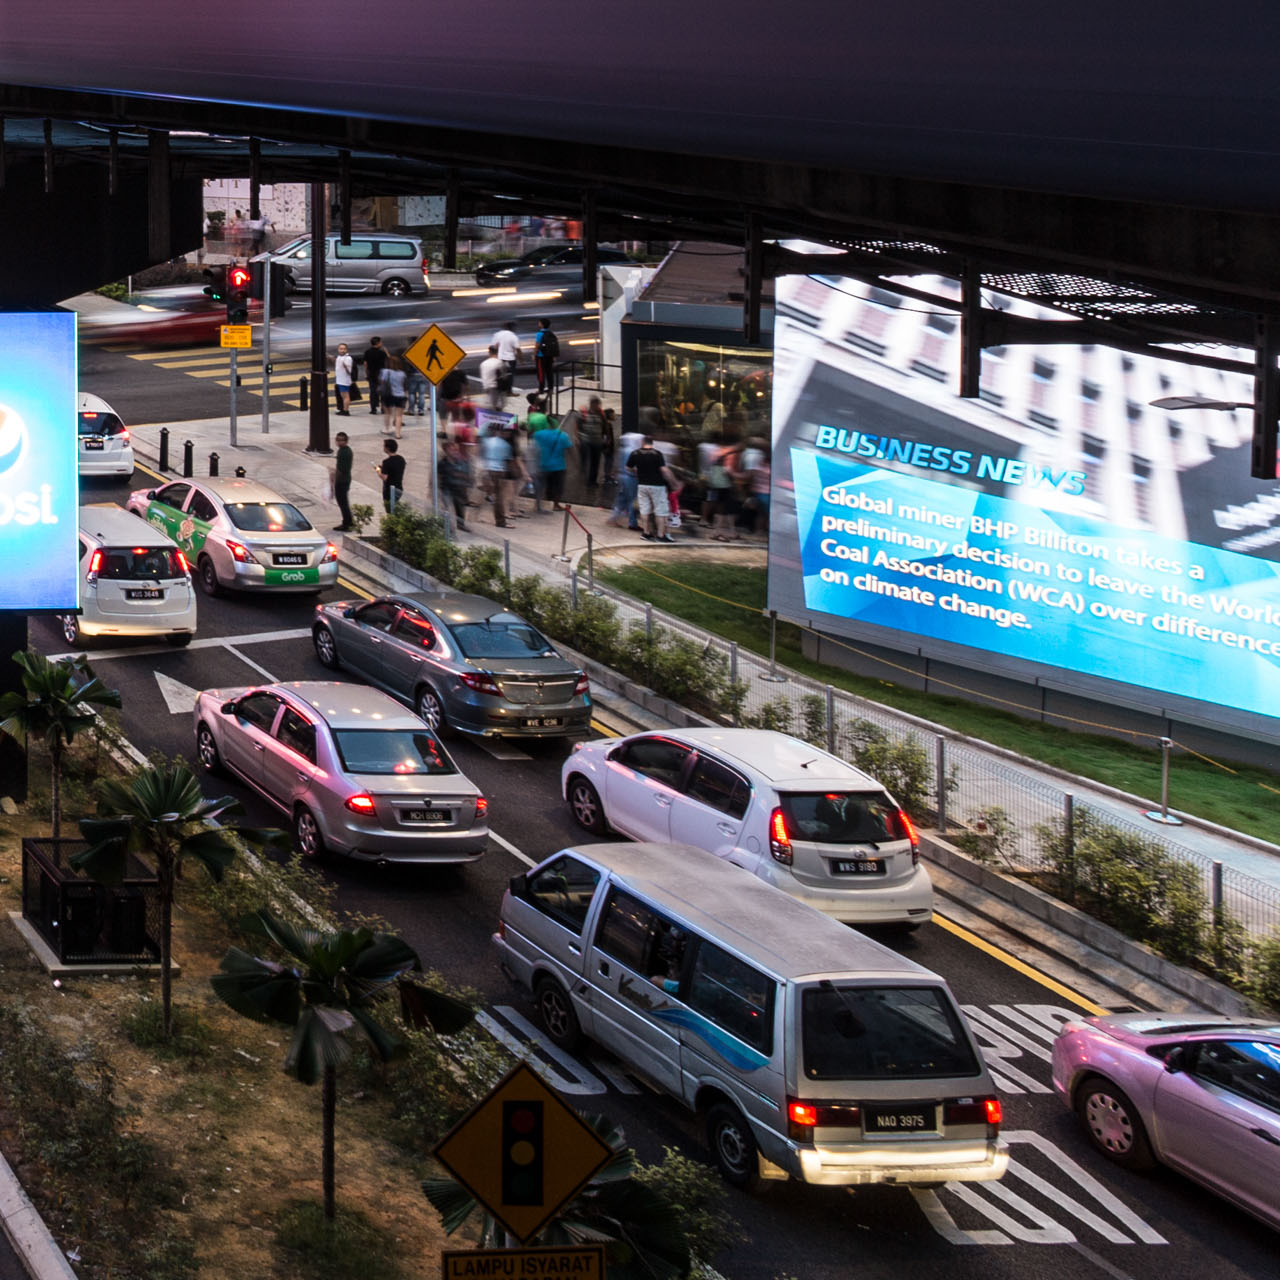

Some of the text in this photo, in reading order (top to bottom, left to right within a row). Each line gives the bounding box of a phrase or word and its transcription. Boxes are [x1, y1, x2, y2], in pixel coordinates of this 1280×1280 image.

[815, 425, 1087, 496] BUSINESS NEWS
[822, 486, 1205, 580] Global miner BHP Billiton takes a
[822, 514, 948, 558] preliminary
[952, 541, 1051, 577] decision
[1056, 564, 1083, 582] to
[1088, 568, 1155, 598] leave
[1161, 586, 1206, 610] the
[281, 572, 305, 582] Grab
[820, 538, 869, 565] Coal
[872, 549, 1003, 596] Association
[1008, 578, 1085, 615] (WCA)
[1090, 601, 1148, 626] over
[820, 568, 1032, 630] on climate change.
[899, 1114, 925, 1127] 3975
[452, 1255, 593, 1277] LAMPU ISYARAT
